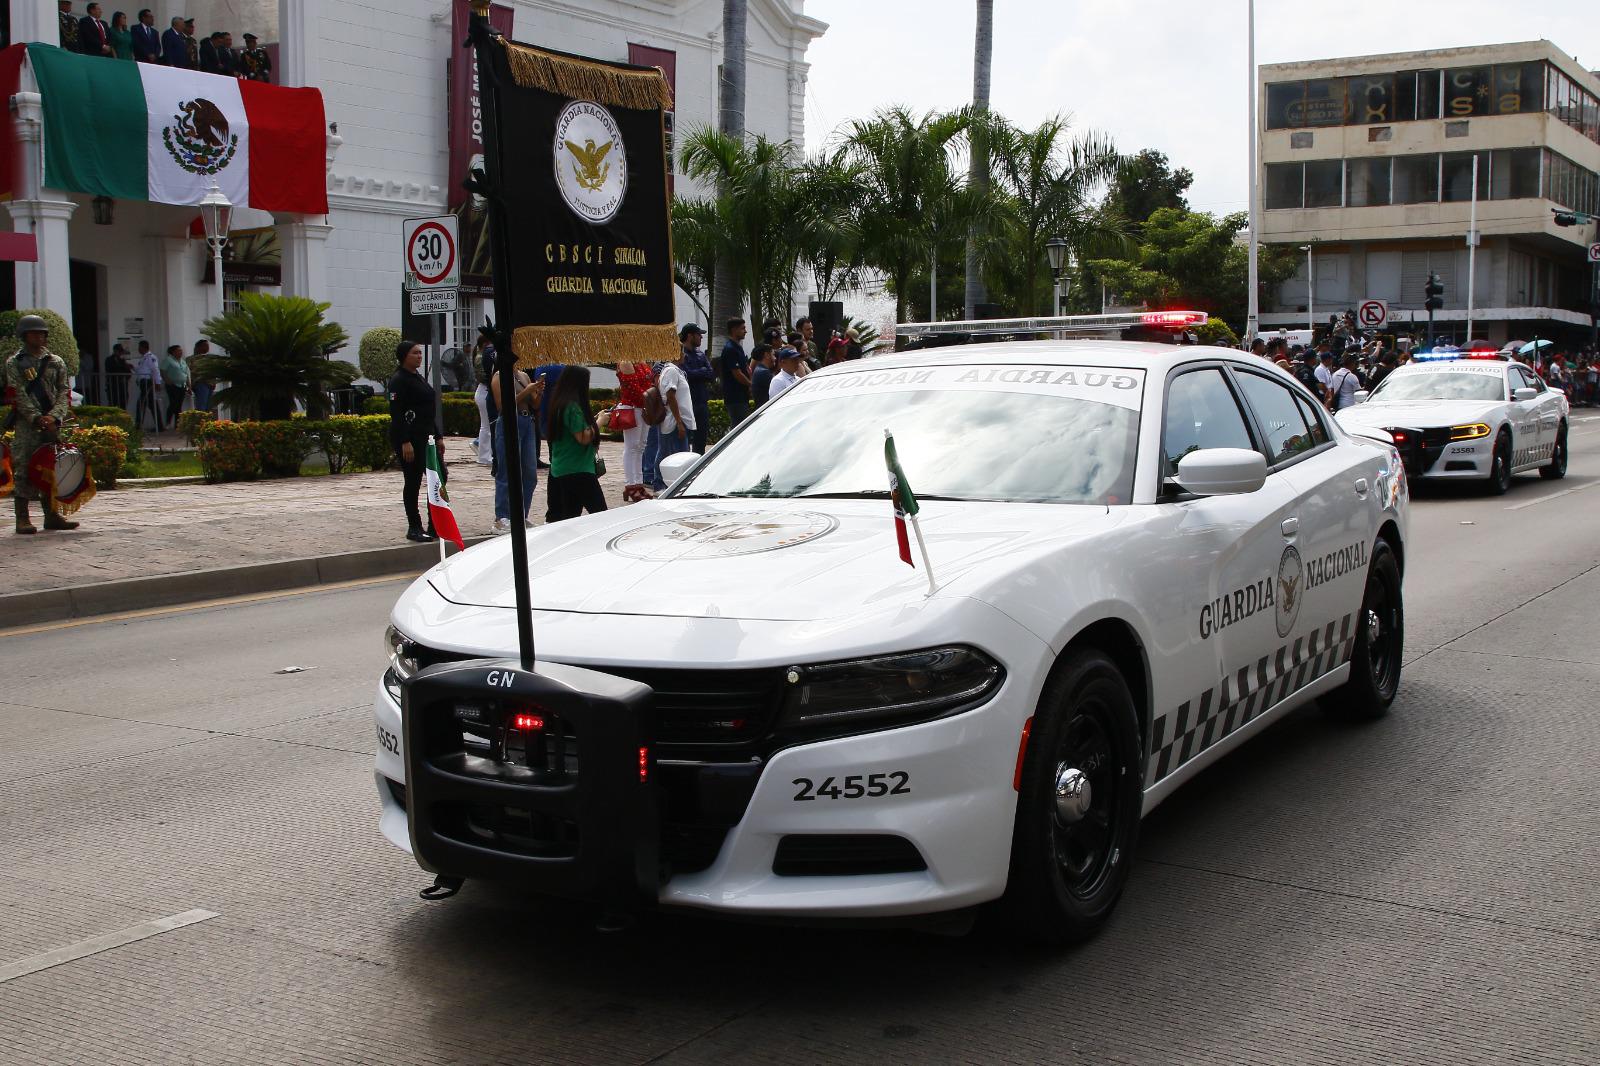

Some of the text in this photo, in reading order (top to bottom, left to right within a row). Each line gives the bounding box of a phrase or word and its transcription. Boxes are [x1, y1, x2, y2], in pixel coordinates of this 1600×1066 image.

[557, 104, 620, 151] GUARDIA NACIONAL
[417, 233, 442, 261] 30
[412, 292, 455, 303] SOLO CARRILES
[546, 276, 648, 296] GUARDIA NACIONAL
[418, 302, 449, 311] LATERALES
[1200, 577, 1275, 640] GUARDIA
[1305, 540, 1368, 590] NACIONAL
[486, 670, 516, 688] GN
[791, 770, 911, 801] 24552
